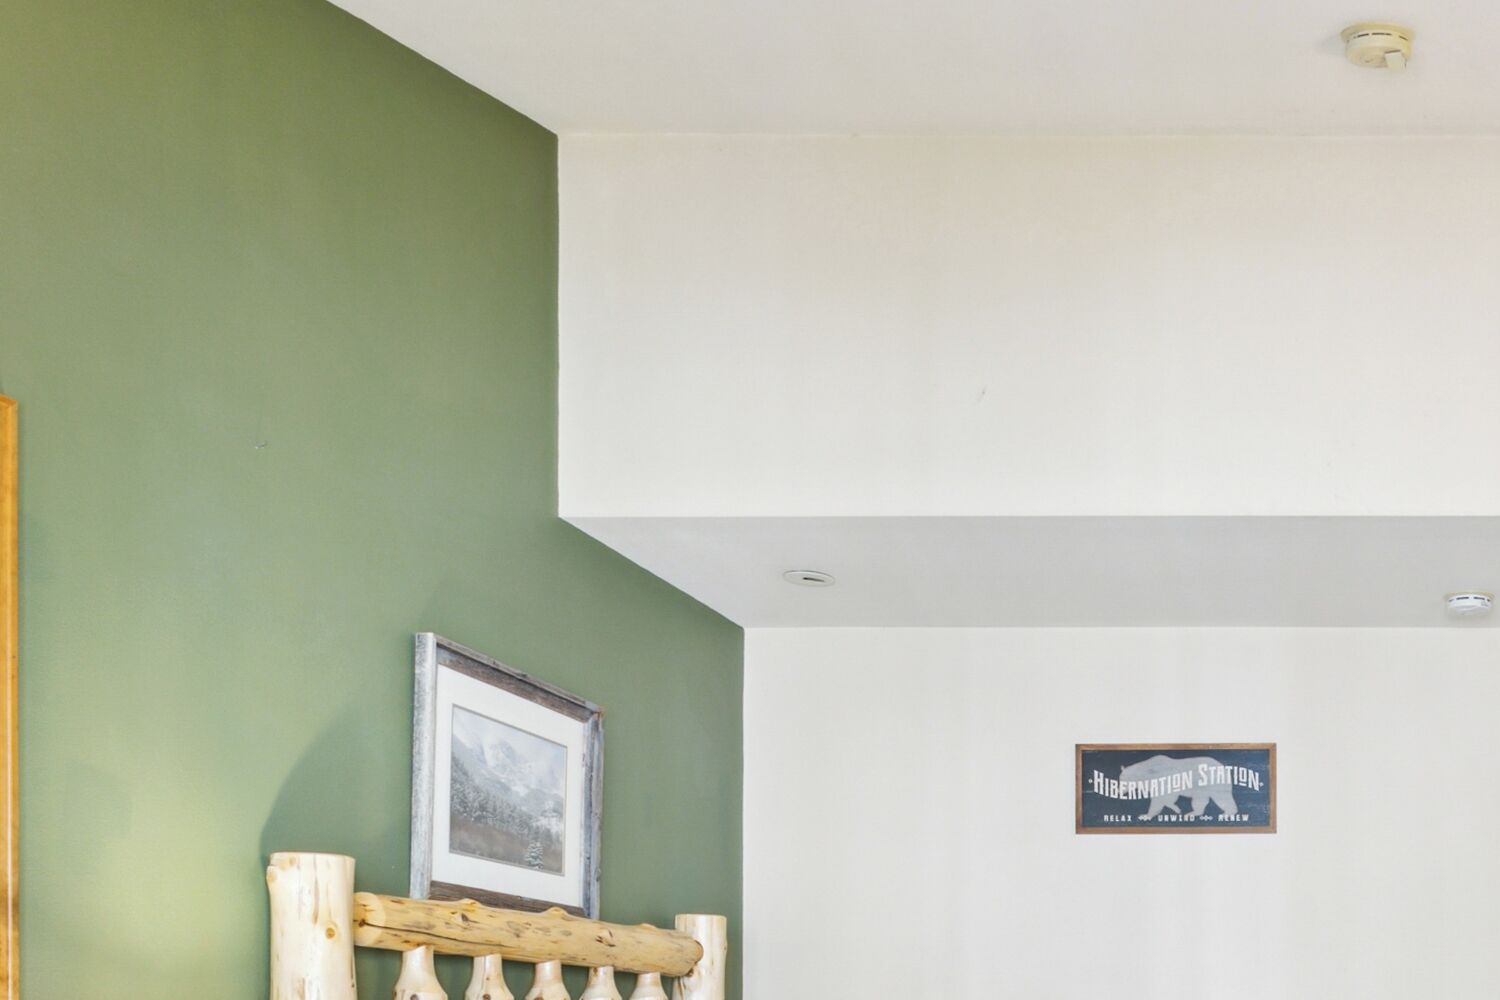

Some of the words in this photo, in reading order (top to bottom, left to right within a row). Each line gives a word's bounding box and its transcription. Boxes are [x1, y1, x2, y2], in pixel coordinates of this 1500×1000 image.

[1093, 769, 1193, 800] HIBERNATION
[1198, 763, 1260, 792] STATION
[1104, 814, 1132, 822] RELAX
[1157, 814, 1195, 822] UNWIND
[1217, 814, 1249, 822] RENEW
